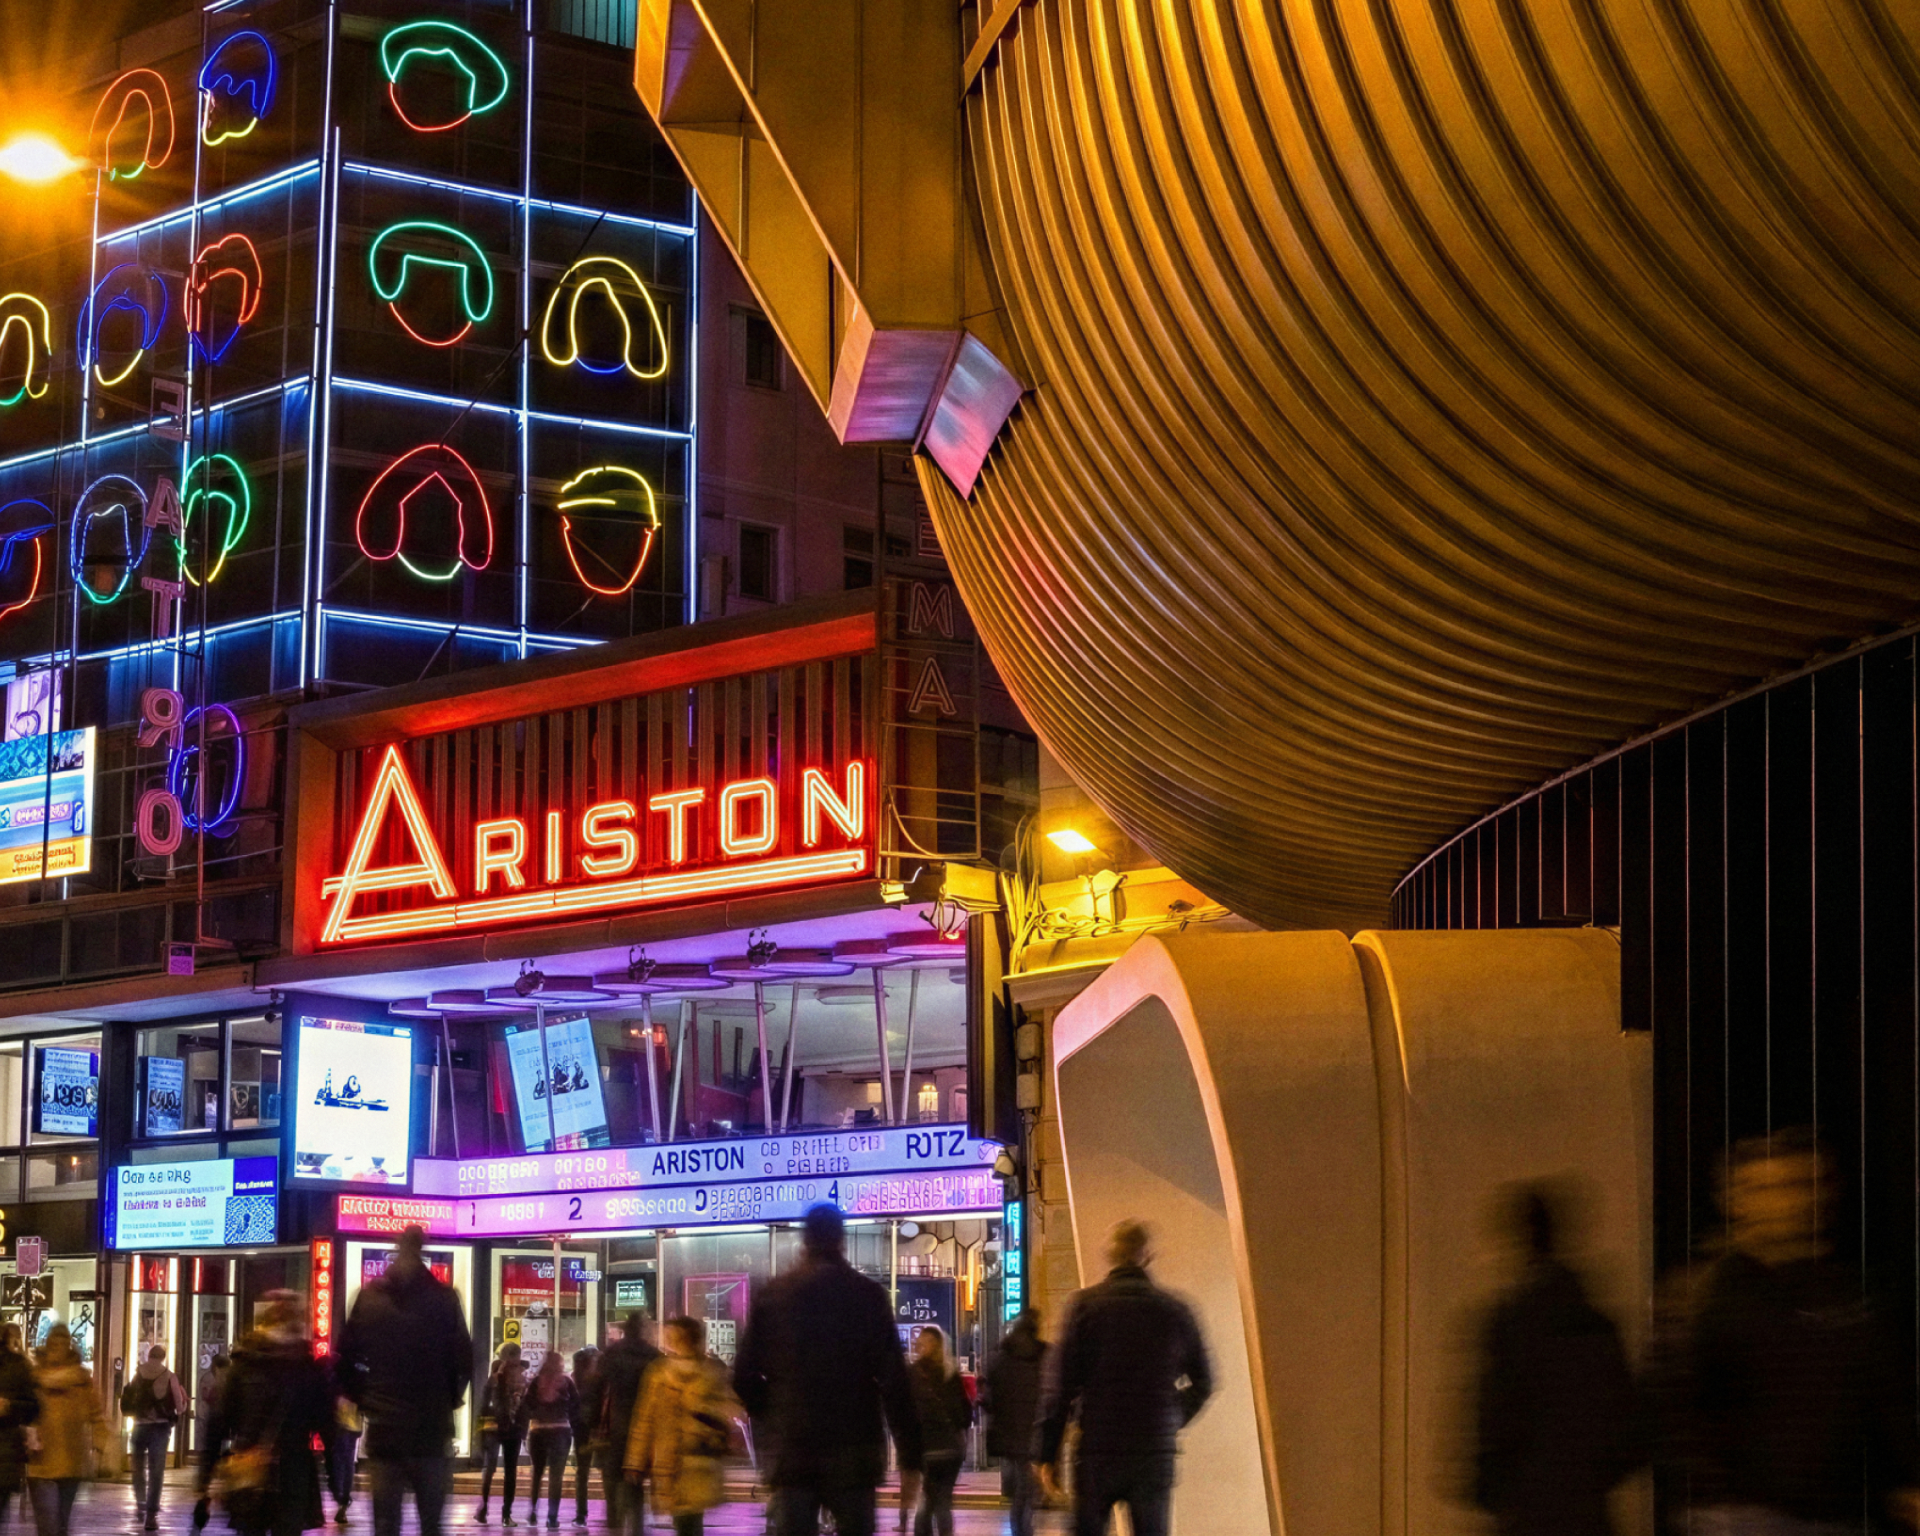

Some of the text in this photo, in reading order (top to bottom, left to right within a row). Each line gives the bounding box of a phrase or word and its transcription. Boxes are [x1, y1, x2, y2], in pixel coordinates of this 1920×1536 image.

[321, 743, 863, 942] ARISTON
[652, 1146, 745, 1176] ARISTON
[568, 1197, 583, 1221] 2
